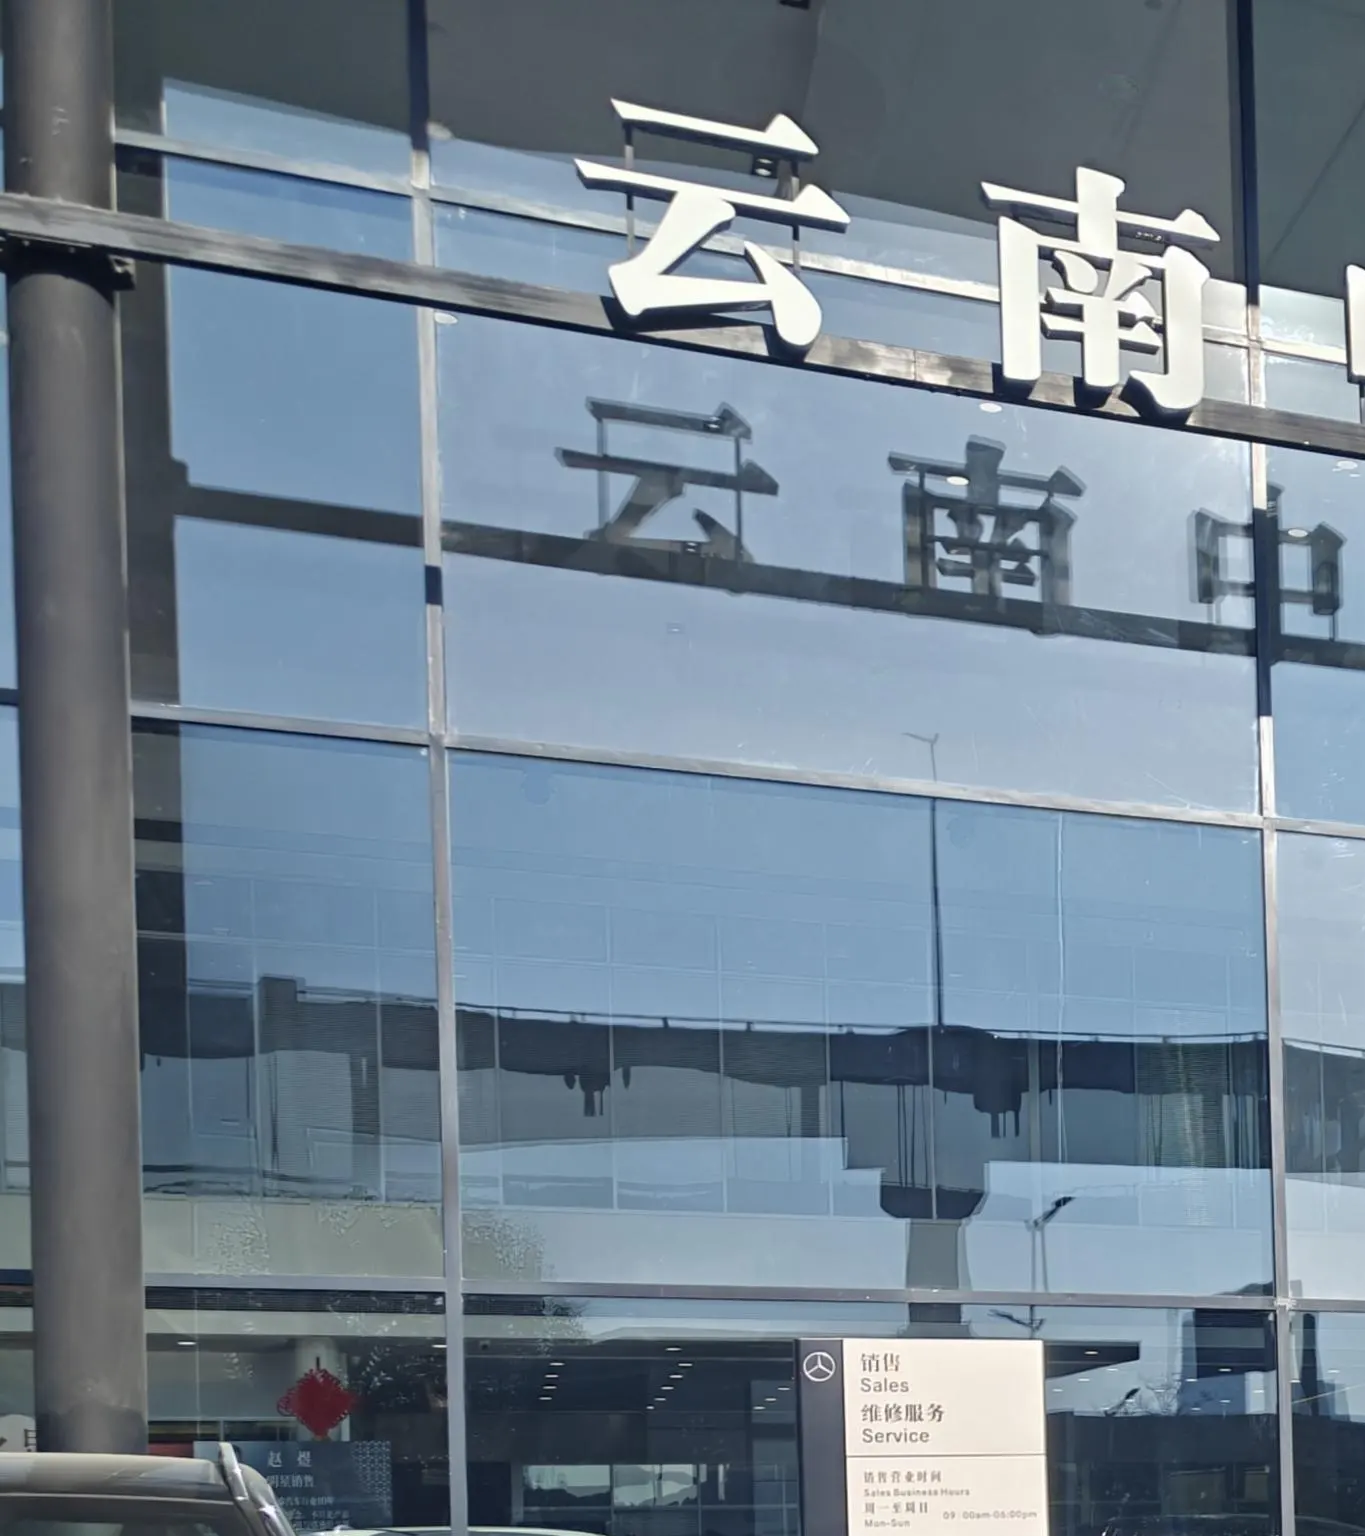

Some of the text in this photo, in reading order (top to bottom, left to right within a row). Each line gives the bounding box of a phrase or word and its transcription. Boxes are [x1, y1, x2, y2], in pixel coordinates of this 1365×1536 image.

[860, 1353, 901, 1373] 销售
[860, 1378, 910, 1393] Sales
[861, 1403, 945, 1423] 维修服务
[862, 1428, 930, 1444] Service
[863, 1471, 942, 1483] 销售营业时间
[863, 1487, 970, 1497] Sales Business Hours
[864, 1519, 911, 1528] Mon-Sun
